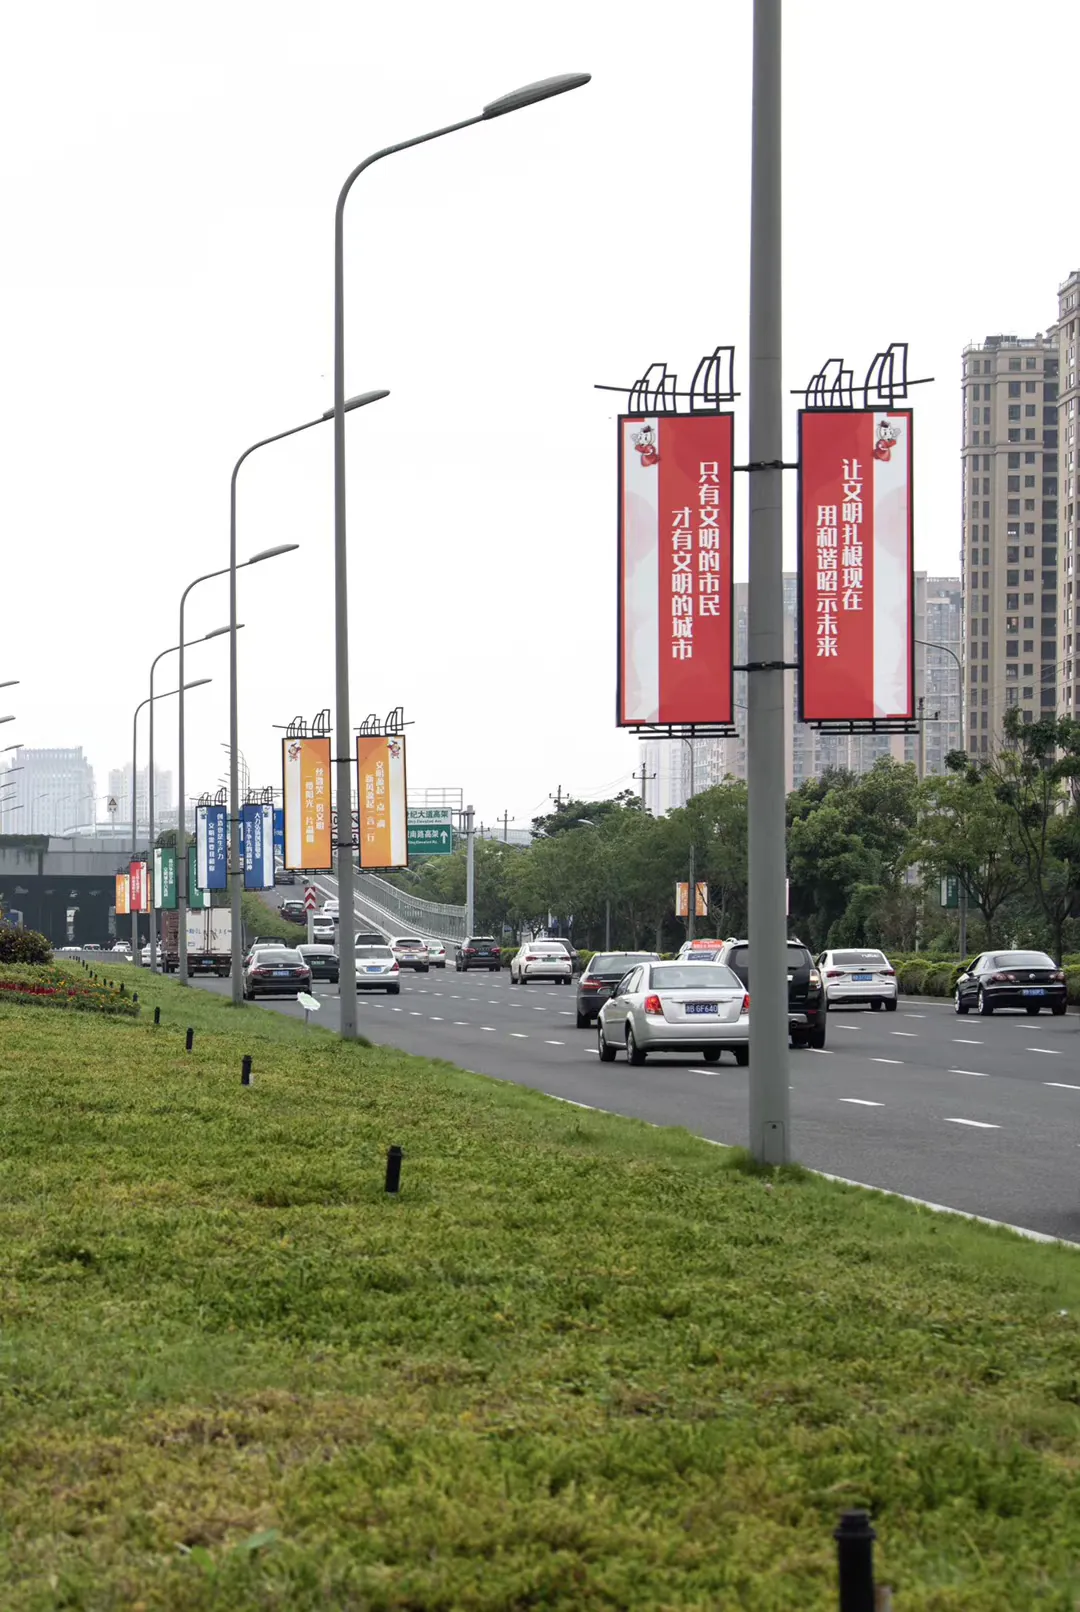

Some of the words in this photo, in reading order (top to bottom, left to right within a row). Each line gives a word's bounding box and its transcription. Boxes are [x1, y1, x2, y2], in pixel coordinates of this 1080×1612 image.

[671, 506, 693, 660] 才有文明的城市
[698, 460, 720, 617] 只有文明的市民
[816, 504, 838, 657] 用和谐昭示未来
[841, 458, 863, 611] 让文明扎根现在
